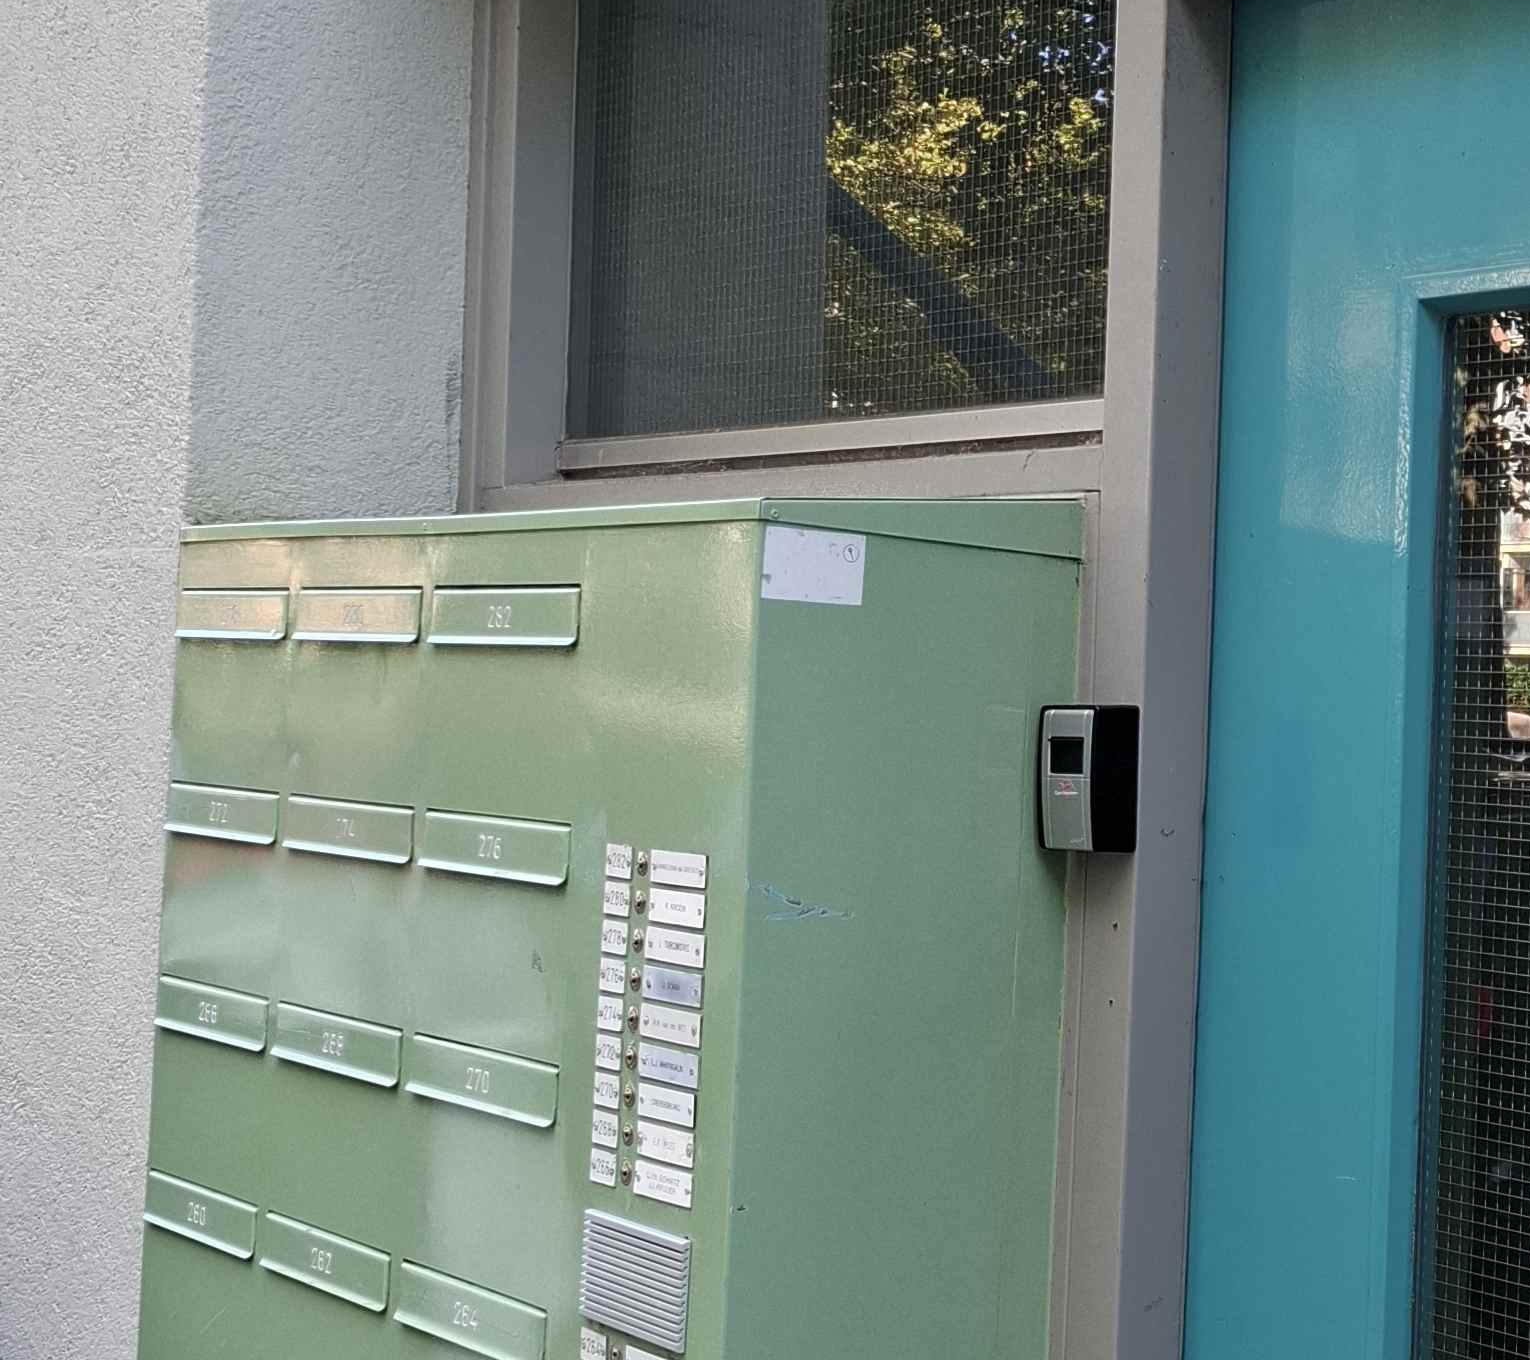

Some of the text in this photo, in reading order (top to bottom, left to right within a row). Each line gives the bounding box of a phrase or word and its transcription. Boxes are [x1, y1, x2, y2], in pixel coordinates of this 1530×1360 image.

[465, 1067, 490, 1094] 270
[187, 1201, 208, 1226] 260
[311, 1247, 333, 1275] 262
[453, 1301, 479, 1330] 264
